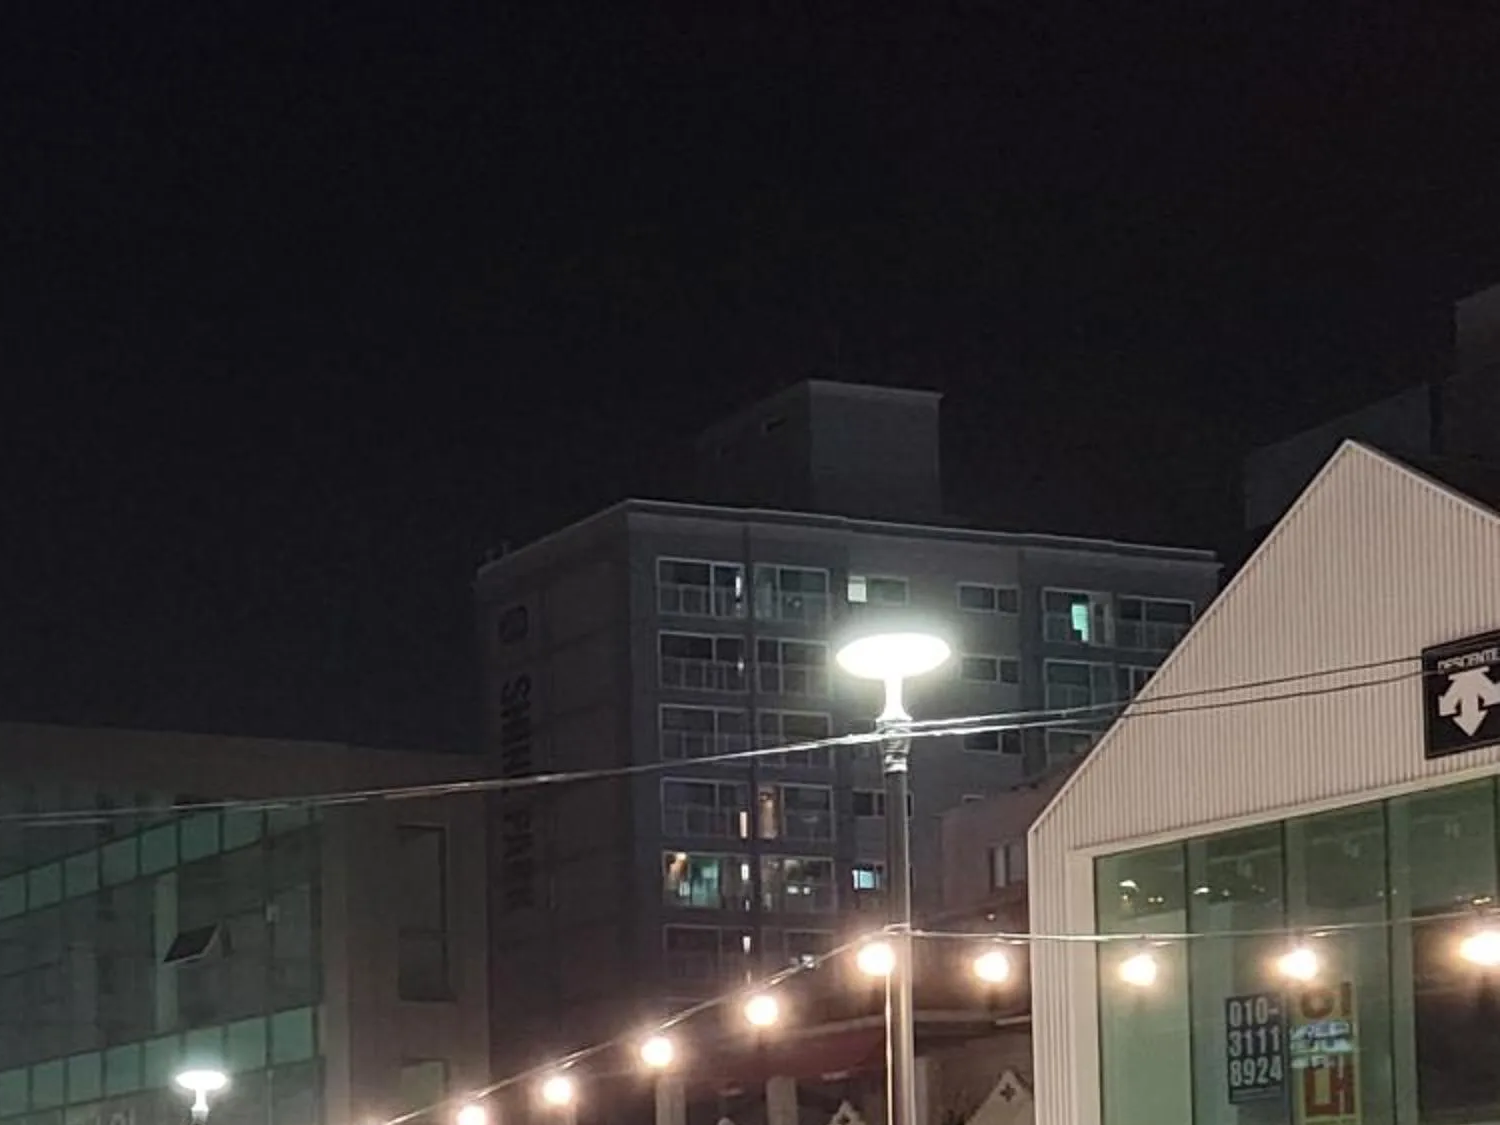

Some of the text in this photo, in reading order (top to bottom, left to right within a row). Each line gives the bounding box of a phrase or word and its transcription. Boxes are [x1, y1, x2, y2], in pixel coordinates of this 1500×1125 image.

[1229, 996, 1280, 1028] 010-
[1228, 1025, 1281, 1057] 3111
[1229, 1054, 1283, 1088] 8924
